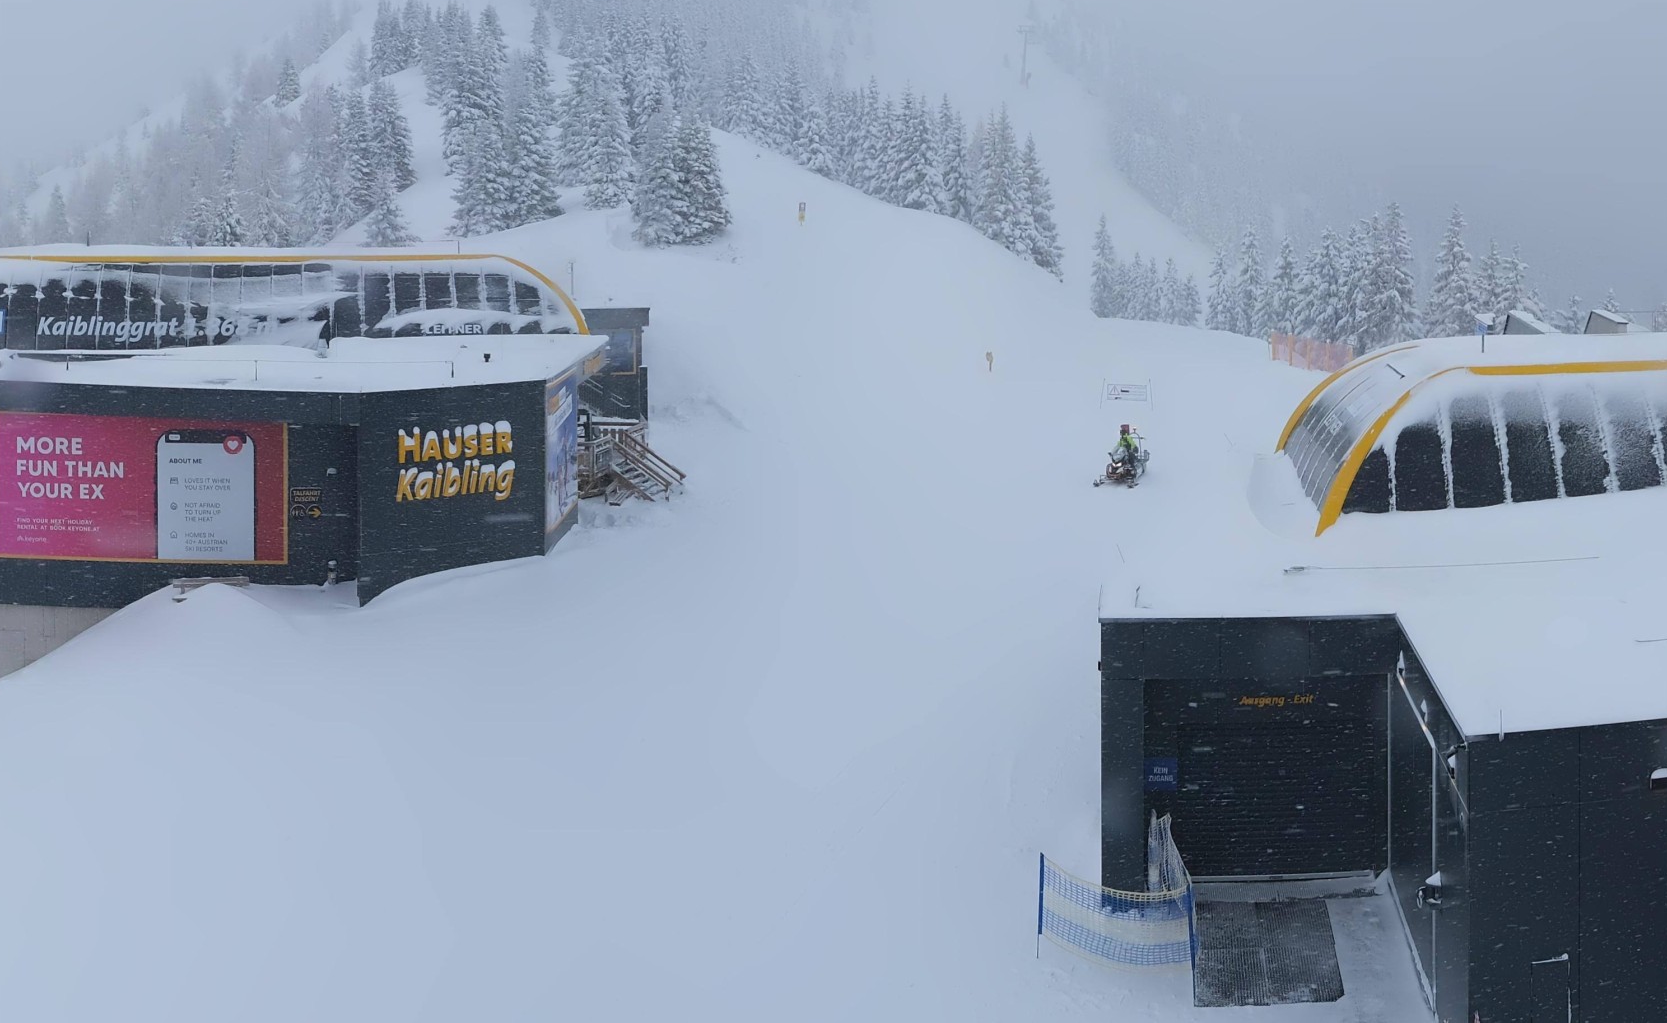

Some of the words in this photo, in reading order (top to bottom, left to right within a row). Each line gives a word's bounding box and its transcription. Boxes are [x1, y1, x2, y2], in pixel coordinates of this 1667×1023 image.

[38, 315, 179, 343] Kaiblinggrat
[16, 436, 83, 455] MORE
[397, 426, 513, 464] HAUSER
[16, 459, 58, 477] FUN
[64, 461, 124, 479] THAN
[17, 482, 73, 499] YOUR
[79, 484, 104, 500] EX
[395, 460, 516, 502] Kaibling
[1239, 696, 1285, 708] Ausgang
[1293, 694, 1314, 704] Exit
